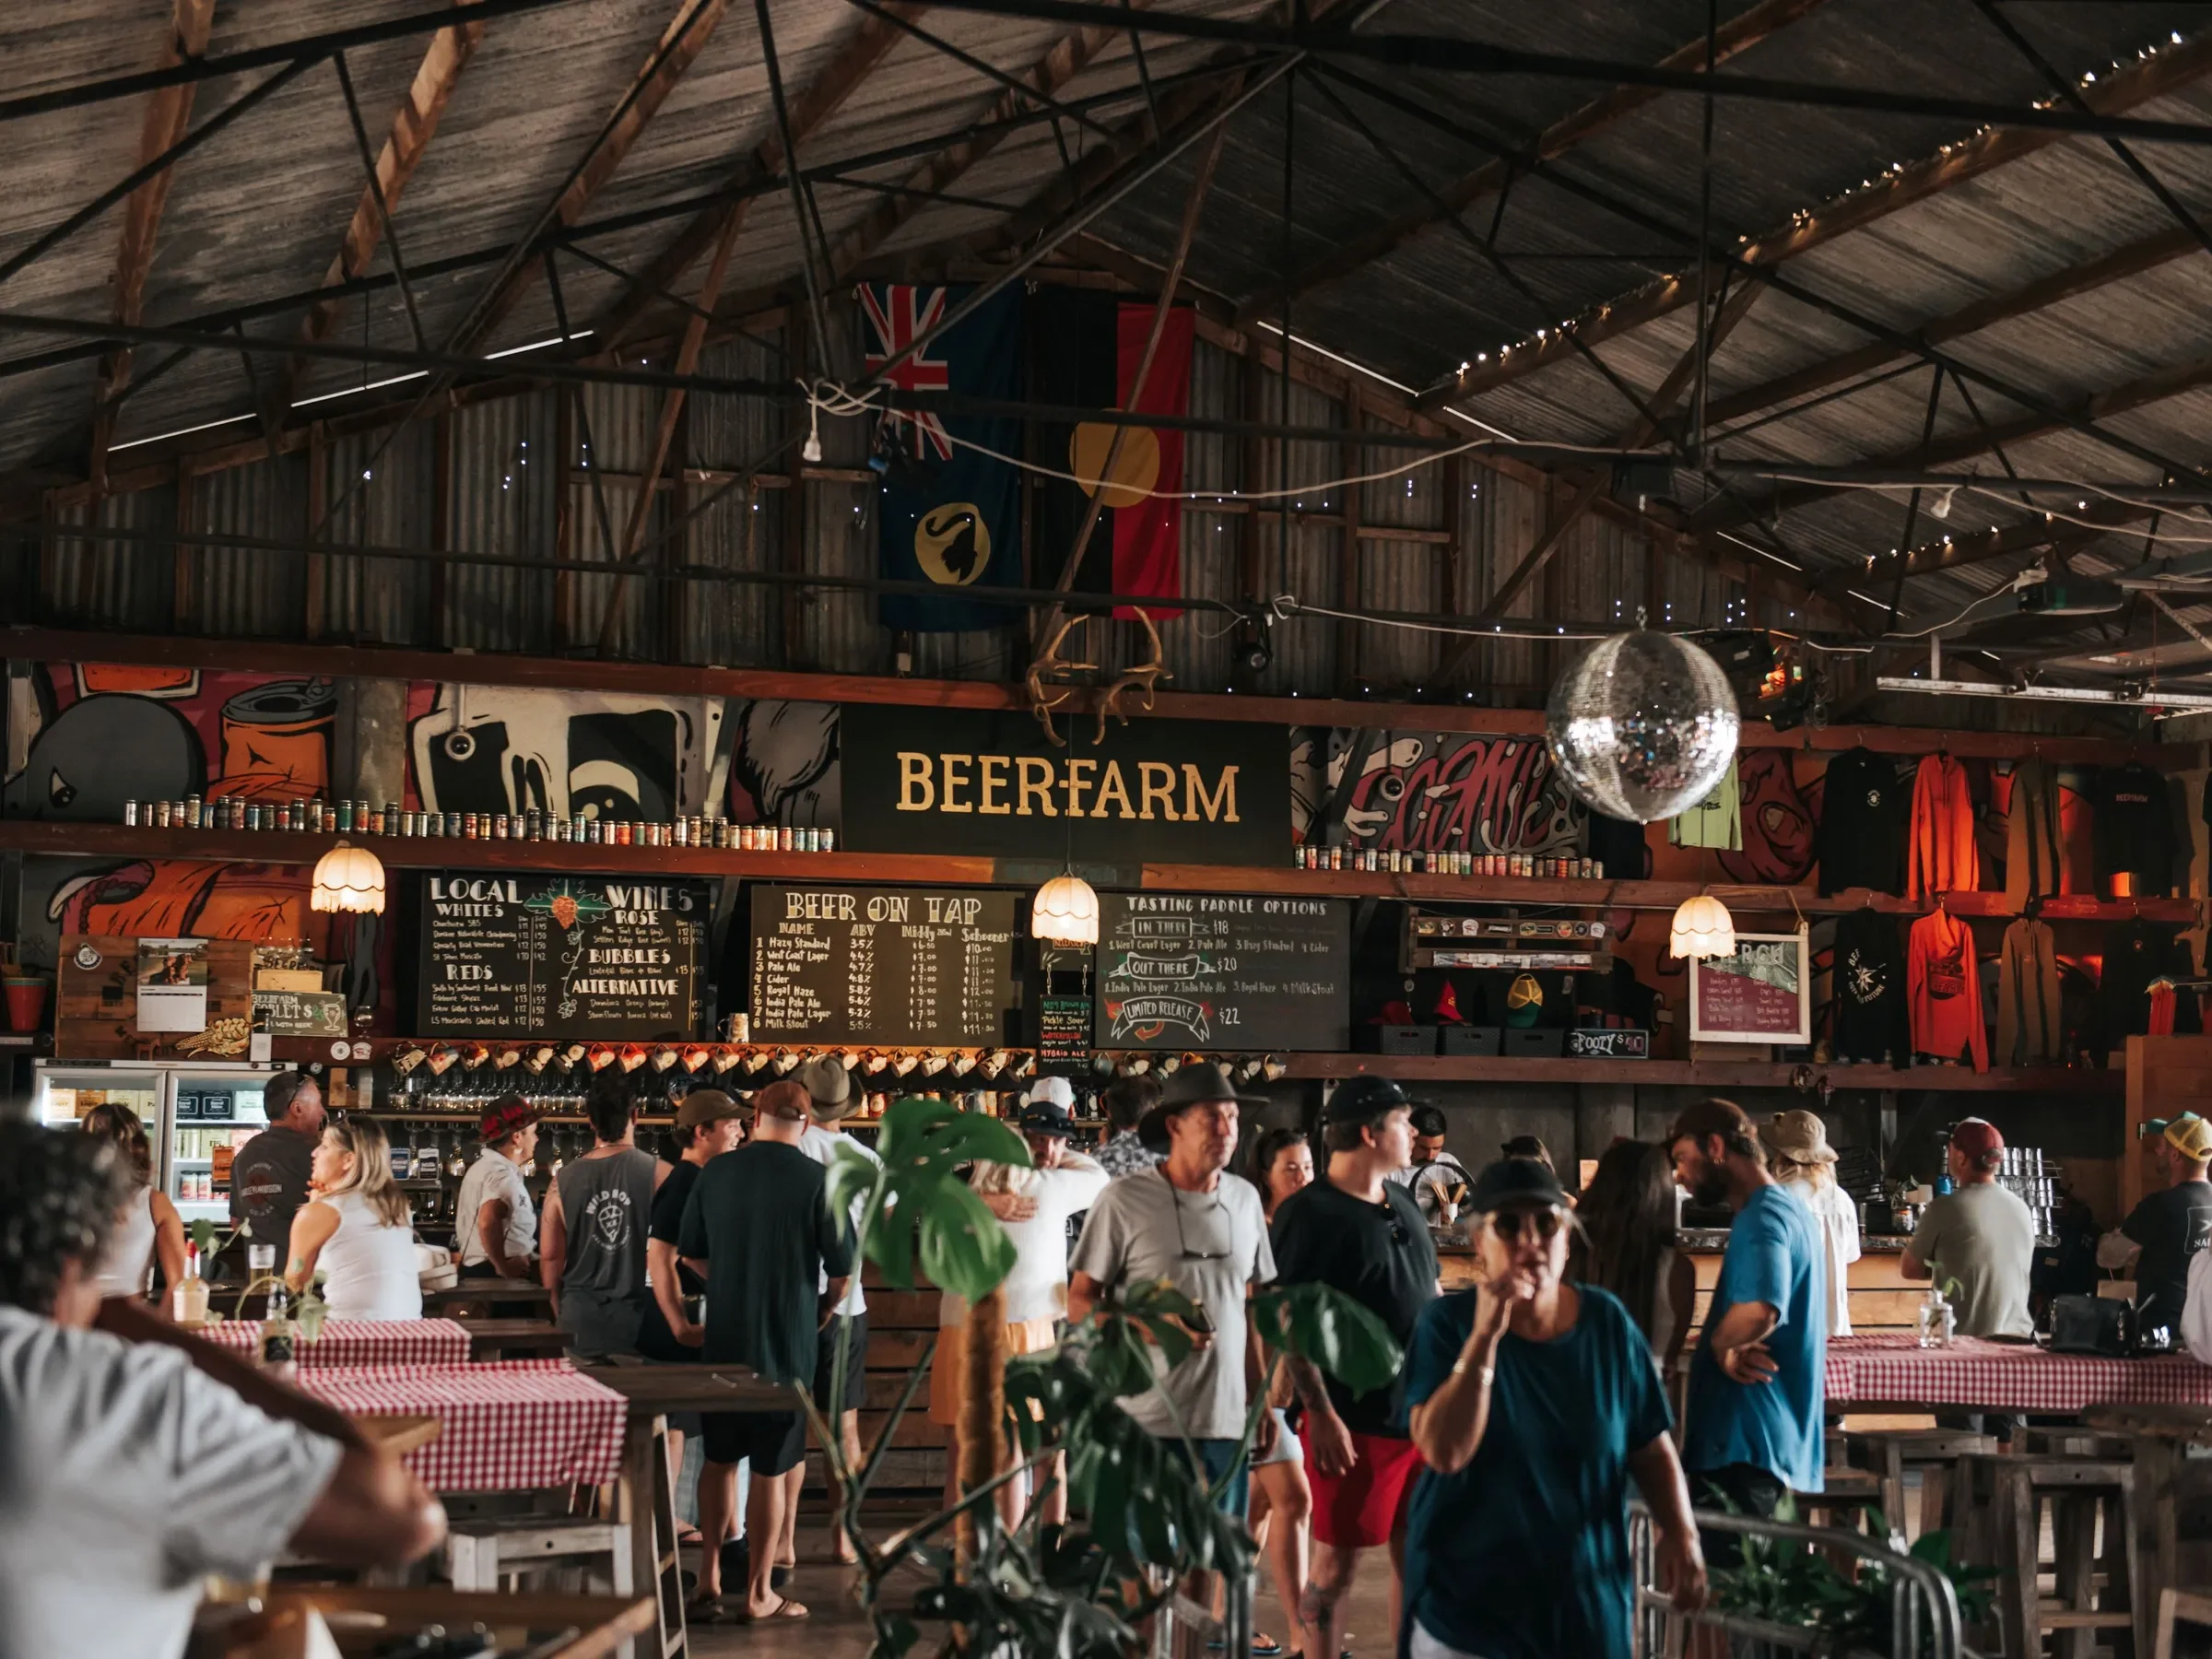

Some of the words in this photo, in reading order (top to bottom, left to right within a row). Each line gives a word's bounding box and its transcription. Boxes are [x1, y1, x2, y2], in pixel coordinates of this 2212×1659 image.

[429, 877, 524, 904] LOCAL
[606, 885, 693, 912] WINES
[435, 903, 504, 917] WHITES
[785, 892, 857, 920] BEER
[867, 896, 910, 923] ON
[924, 898, 982, 924] TAP
[1126, 897, 1194, 912] TASTING
[1200, 899, 1253, 913] PADDLE
[1264, 900, 1327, 916] OPTIONS
[615, 910, 659, 925] ROSE
[779, 923, 815, 935] NAME
[850, 924, 877, 936] ABV
[901, 925, 935, 942] Middy
[961, 927, 1010, 943] Schooner
[1138, 922, 1151, 934] IN
[1156, 922, 1187, 934] THERE
[1214, 919, 1229, 935] $18
[756, 937, 763, 947] 1
[770, 936, 792, 950] Hazy
[794, 936, 830, 950] Standard
[588, 948, 671, 964] BUBBLES
[756, 950, 763, 960] 2
[767, 949, 784, 959] West
[785, 949, 806, 960] Coast
[807, 951, 830, 962] Lager
[446, 964, 493, 981] REDS
[756, 961, 764, 971] 3
[768, 962, 784, 971] Pale
[786, 962, 801, 972] Ale
[1133, 962, 1154, 975] OUT
[1158, 962, 1189, 975] THERE
[1218, 957, 1237, 973] $20
[766, 973, 790, 984] Cider
[571, 979, 679, 995] ALTERNATIVE
[753, 984, 762, 995] 5
[767, 983, 791, 996] Royal
[794, 985, 815, 996] Haze
[754, 995, 762, 1006] 6
[766, 996, 785, 1006] India
[788, 996, 805, 1008] Pale
[807, 998, 821, 1008] Ale
[753, 1006, 762, 1017] 7
[765, 1007, 785, 1018] India
[787, 1008, 804, 1018] Pale
[807, 1009, 831, 1023] Lager
[1126, 1001, 1157, 1019] LIMITED
[1159, 1001, 1194, 1020] RELEASE
[1219, 1007, 1241, 1025] $22
[752, 1018, 761, 1029] 8
[765, 1018, 785, 1029] Milk
[786, 1019, 809, 1030] Stout
[1571, 1032, 1617, 1055] FOOTY
[585, 1190, 610, 1215] WILD
